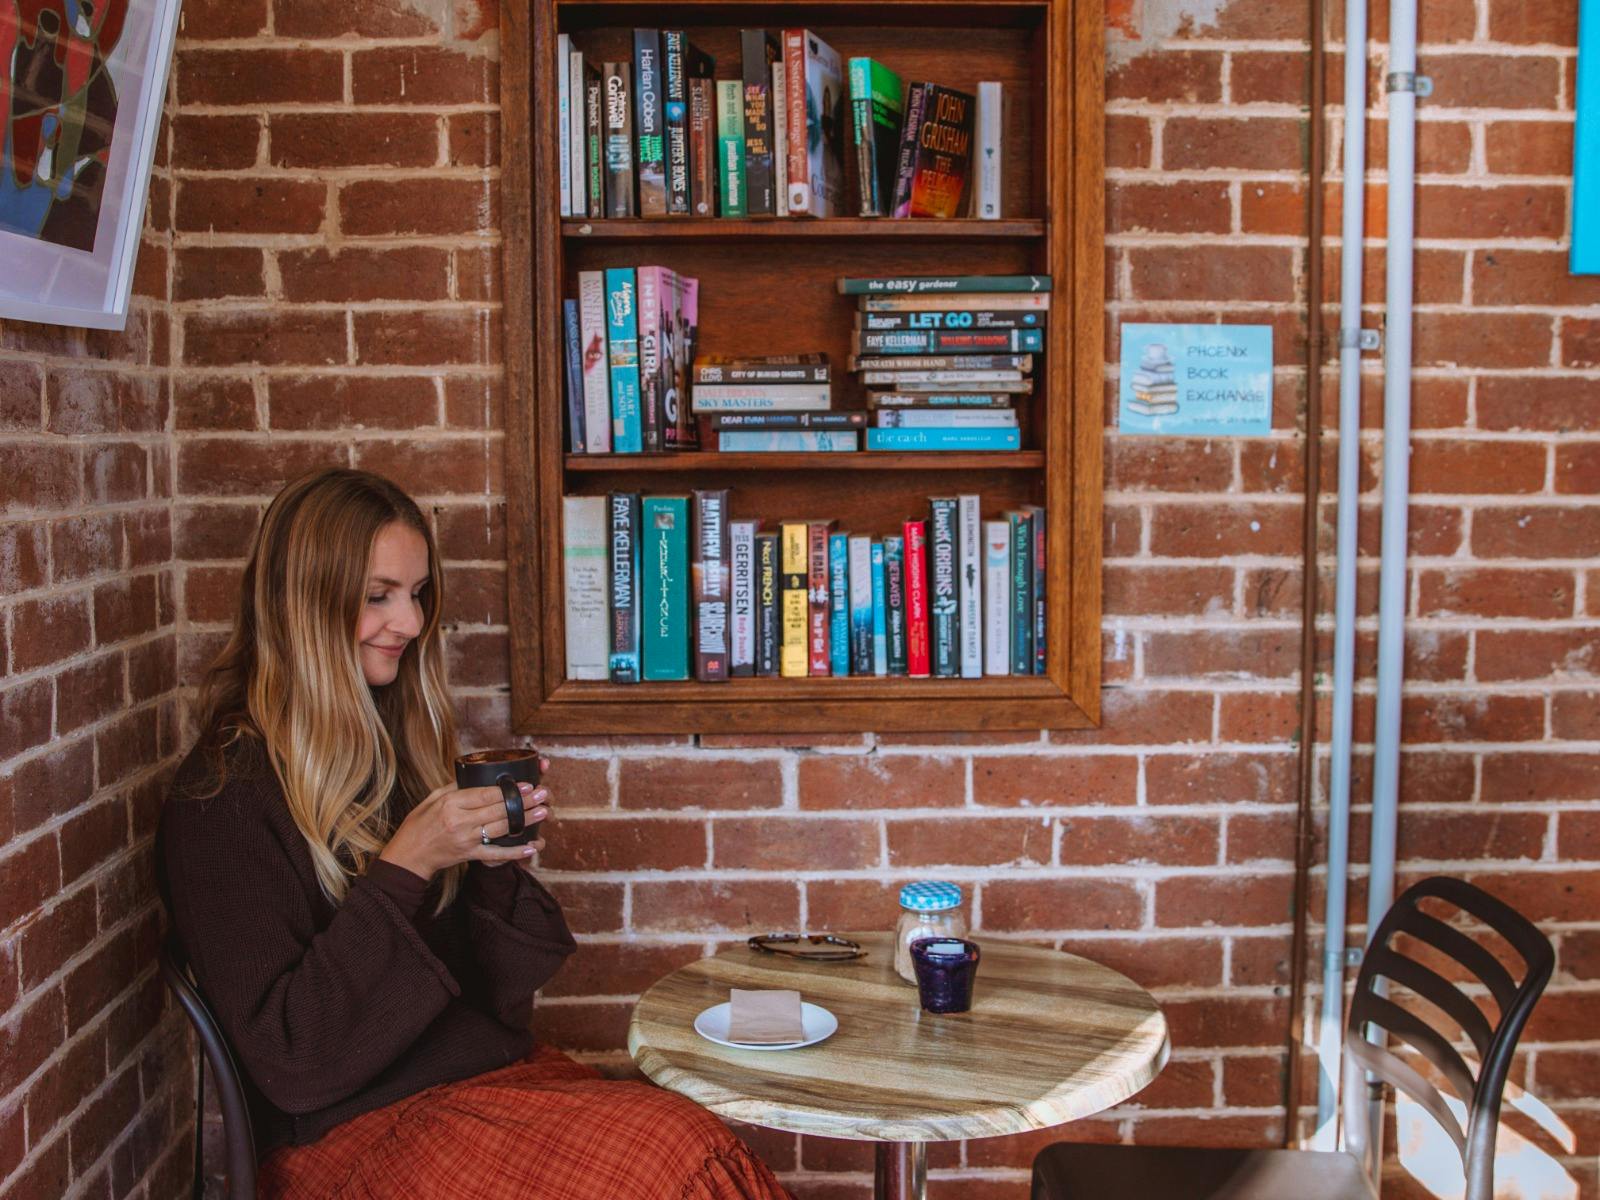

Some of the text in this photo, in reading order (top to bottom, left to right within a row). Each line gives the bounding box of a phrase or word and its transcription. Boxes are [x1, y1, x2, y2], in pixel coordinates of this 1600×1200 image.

[641, 49, 656, 132] Harlan Coben
[668, 53, 682, 98] KELLERMAN
[791, 60, 802, 97] Sister's
[589, 87, 599, 127] Payback
[608, 76, 621, 129] Cornwell
[692, 87, 703, 131] SLAUGHTER
[906, 88, 922, 142] JOHN GRISHAM
[936, 93, 965, 124] JOHN
[791, 100, 803, 146] Courage
[921, 121, 968, 154] GRISHAM
[607, 135, 630, 172] DUST
[640, 135, 651, 163] TWICE
[651, 135, 662, 162] THINK
[900, 149, 910, 177] PELICAN
[936, 155, 952, 172] THE
[673, 166, 685, 192] BONES
[868, 279, 958, 292] the easy gardener
[583, 280, 593, 332] WALTERS
[592, 280, 602, 331] MINETTE
[612, 291, 625, 327] Binchy
[643, 284, 655, 331] NEXT
[909, 313, 943, 328] LET
[945, 312, 973, 328] GO
[643, 335, 657, 379] GIRL
[866, 335, 927, 347] FAYE KELLERMAN
[700, 374, 722, 382] LLOYD
[923, 359, 947, 367] HAND
[1187, 367, 1228, 380] BOOK
[619, 395, 627, 418] SOUL
[626, 384, 635, 416] HEART
[698, 399, 774, 408] SKY MASTERS
[1186, 390, 1265, 401] EXCHANGE
[721, 416, 742, 424] DEAR
[744, 416, 765, 424] EVAN
[966, 500, 974, 522] STELLA
[612, 497, 630, 607] FAYE KELLERMAN
[703, 499, 721, 597] MATTHEW REILLY
[910, 527, 919, 551] MARY
[934, 508, 952, 595] DARK ORIGINS
[1017, 524, 1027, 549] With
[736, 544, 749, 615] GERRITSEN
[762, 541, 773, 606] Nicci FRENCH
[812, 554, 824, 579] HOAG
[911, 554, 920, 589] HIGGINS
[1015, 551, 1027, 588] Enough
[659, 531, 673, 637] INHERITANCE
[834, 562, 844, 611] WILDTRACK
[889, 561, 900, 607] BETRAYED
[912, 591, 921, 619] CLARK
[1017, 590, 1027, 614] Love
[615, 609, 624, 652] DARKNESS
[699, 602, 725, 653] SCARECROW
[738, 617, 747, 634] Body
[814, 614, 823, 627] The
[968, 599, 977, 659] PRESENT DANGER
[765, 639, 773, 658] Gone
[814, 638, 824, 653] Girl
